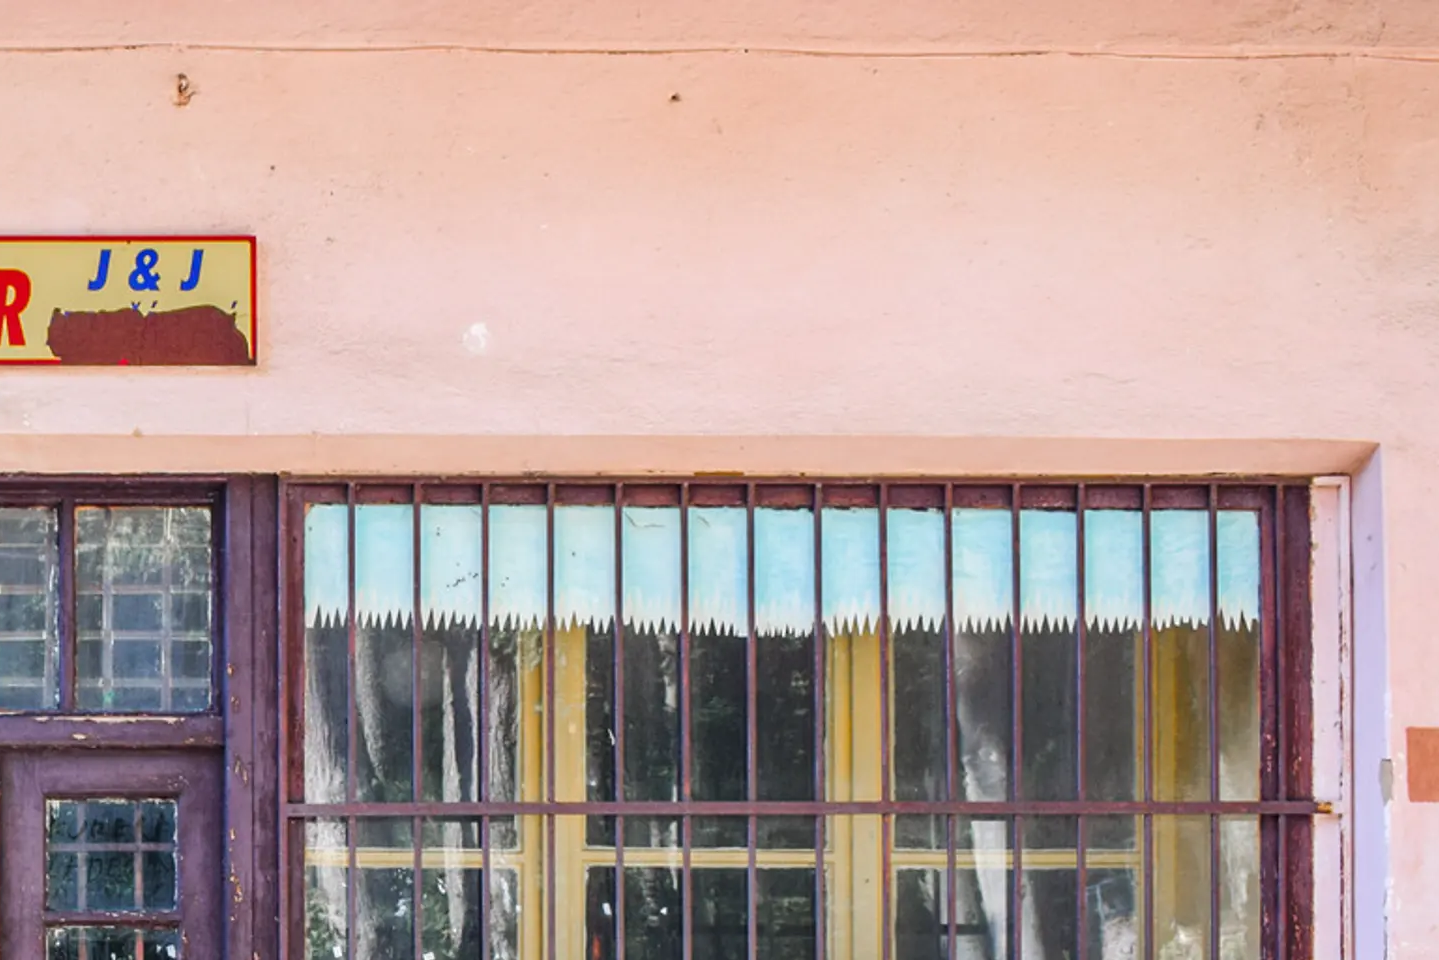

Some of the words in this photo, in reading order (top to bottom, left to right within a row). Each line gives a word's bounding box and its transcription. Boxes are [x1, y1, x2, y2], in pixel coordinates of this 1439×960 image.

[88, 249, 111, 291] J
[128, 248, 161, 291] &
[180, 249, 203, 291] J
